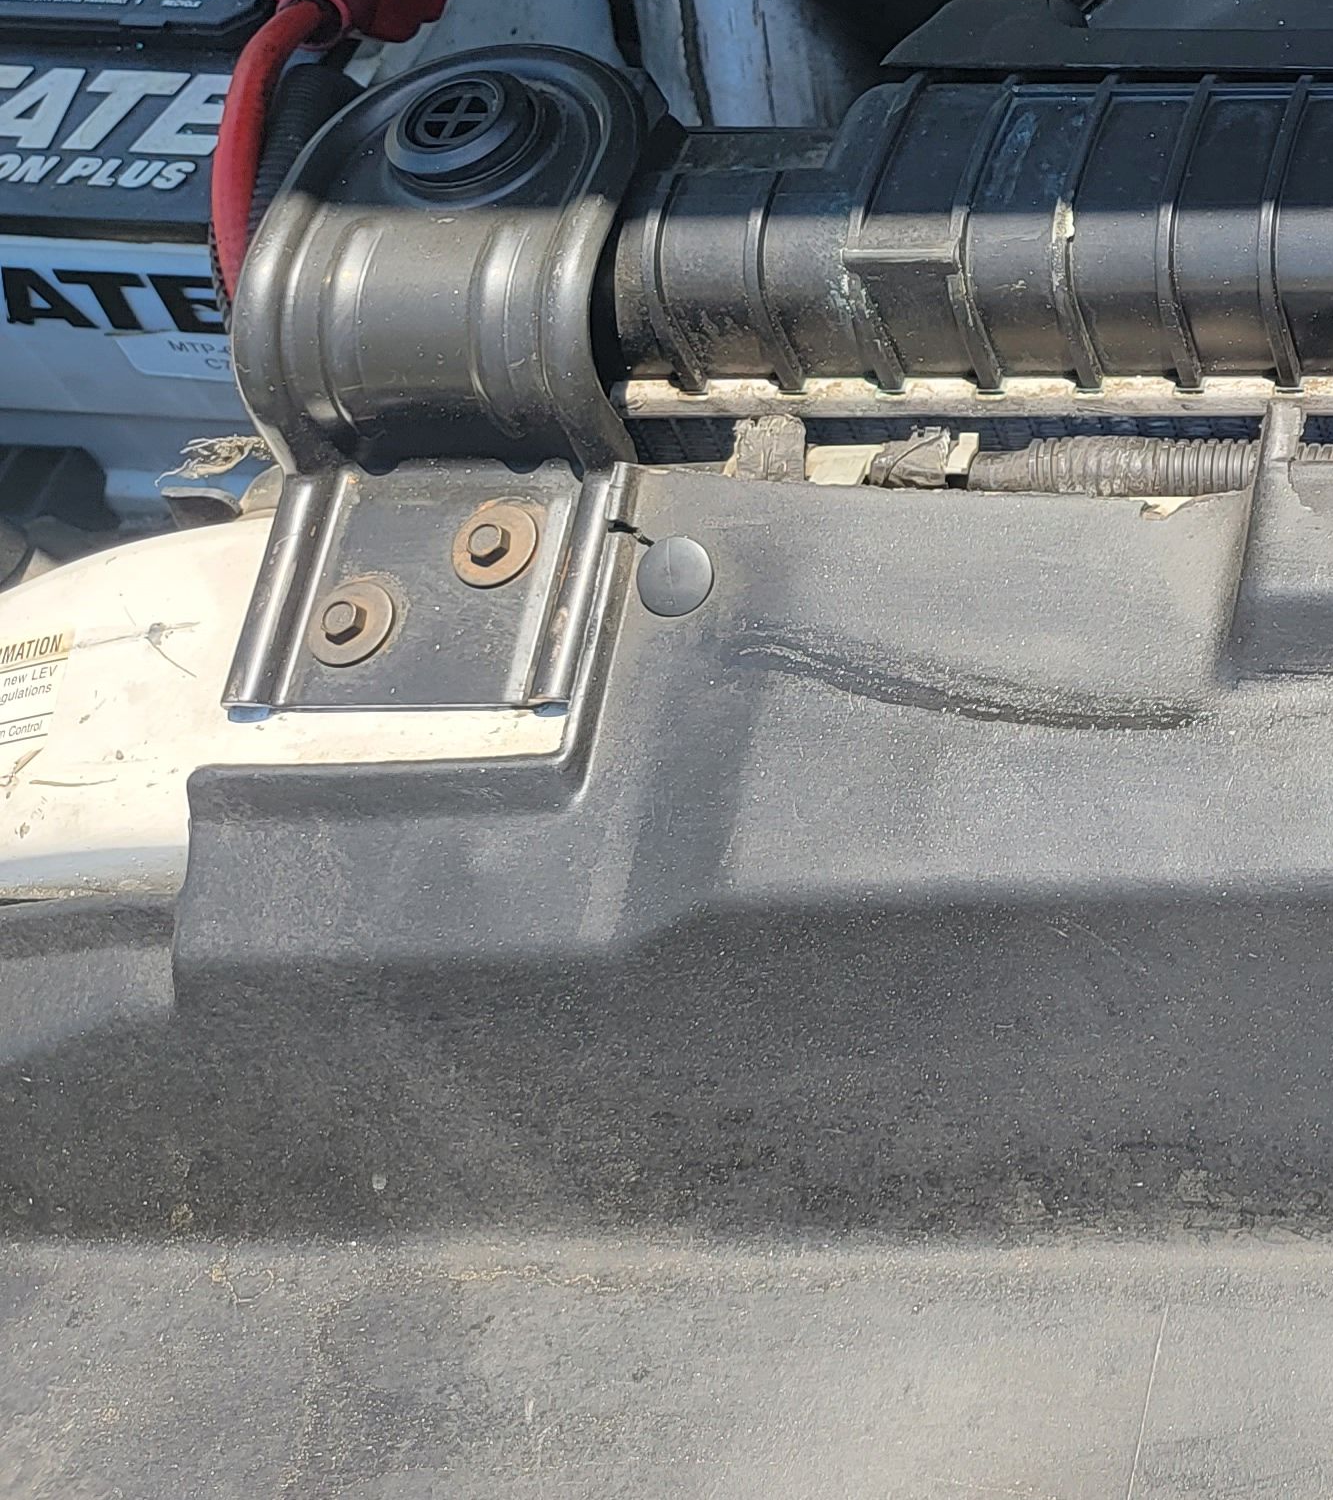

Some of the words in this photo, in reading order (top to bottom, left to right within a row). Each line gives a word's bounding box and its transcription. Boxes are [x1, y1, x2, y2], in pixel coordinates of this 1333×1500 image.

[161, 0, 202, 8] RECYCLE
[57, 156, 196, 190] PLUS
[4, 673, 27, 688] new
[32, 665, 58, 681] LEV
[8, 720, 43, 737] Control
